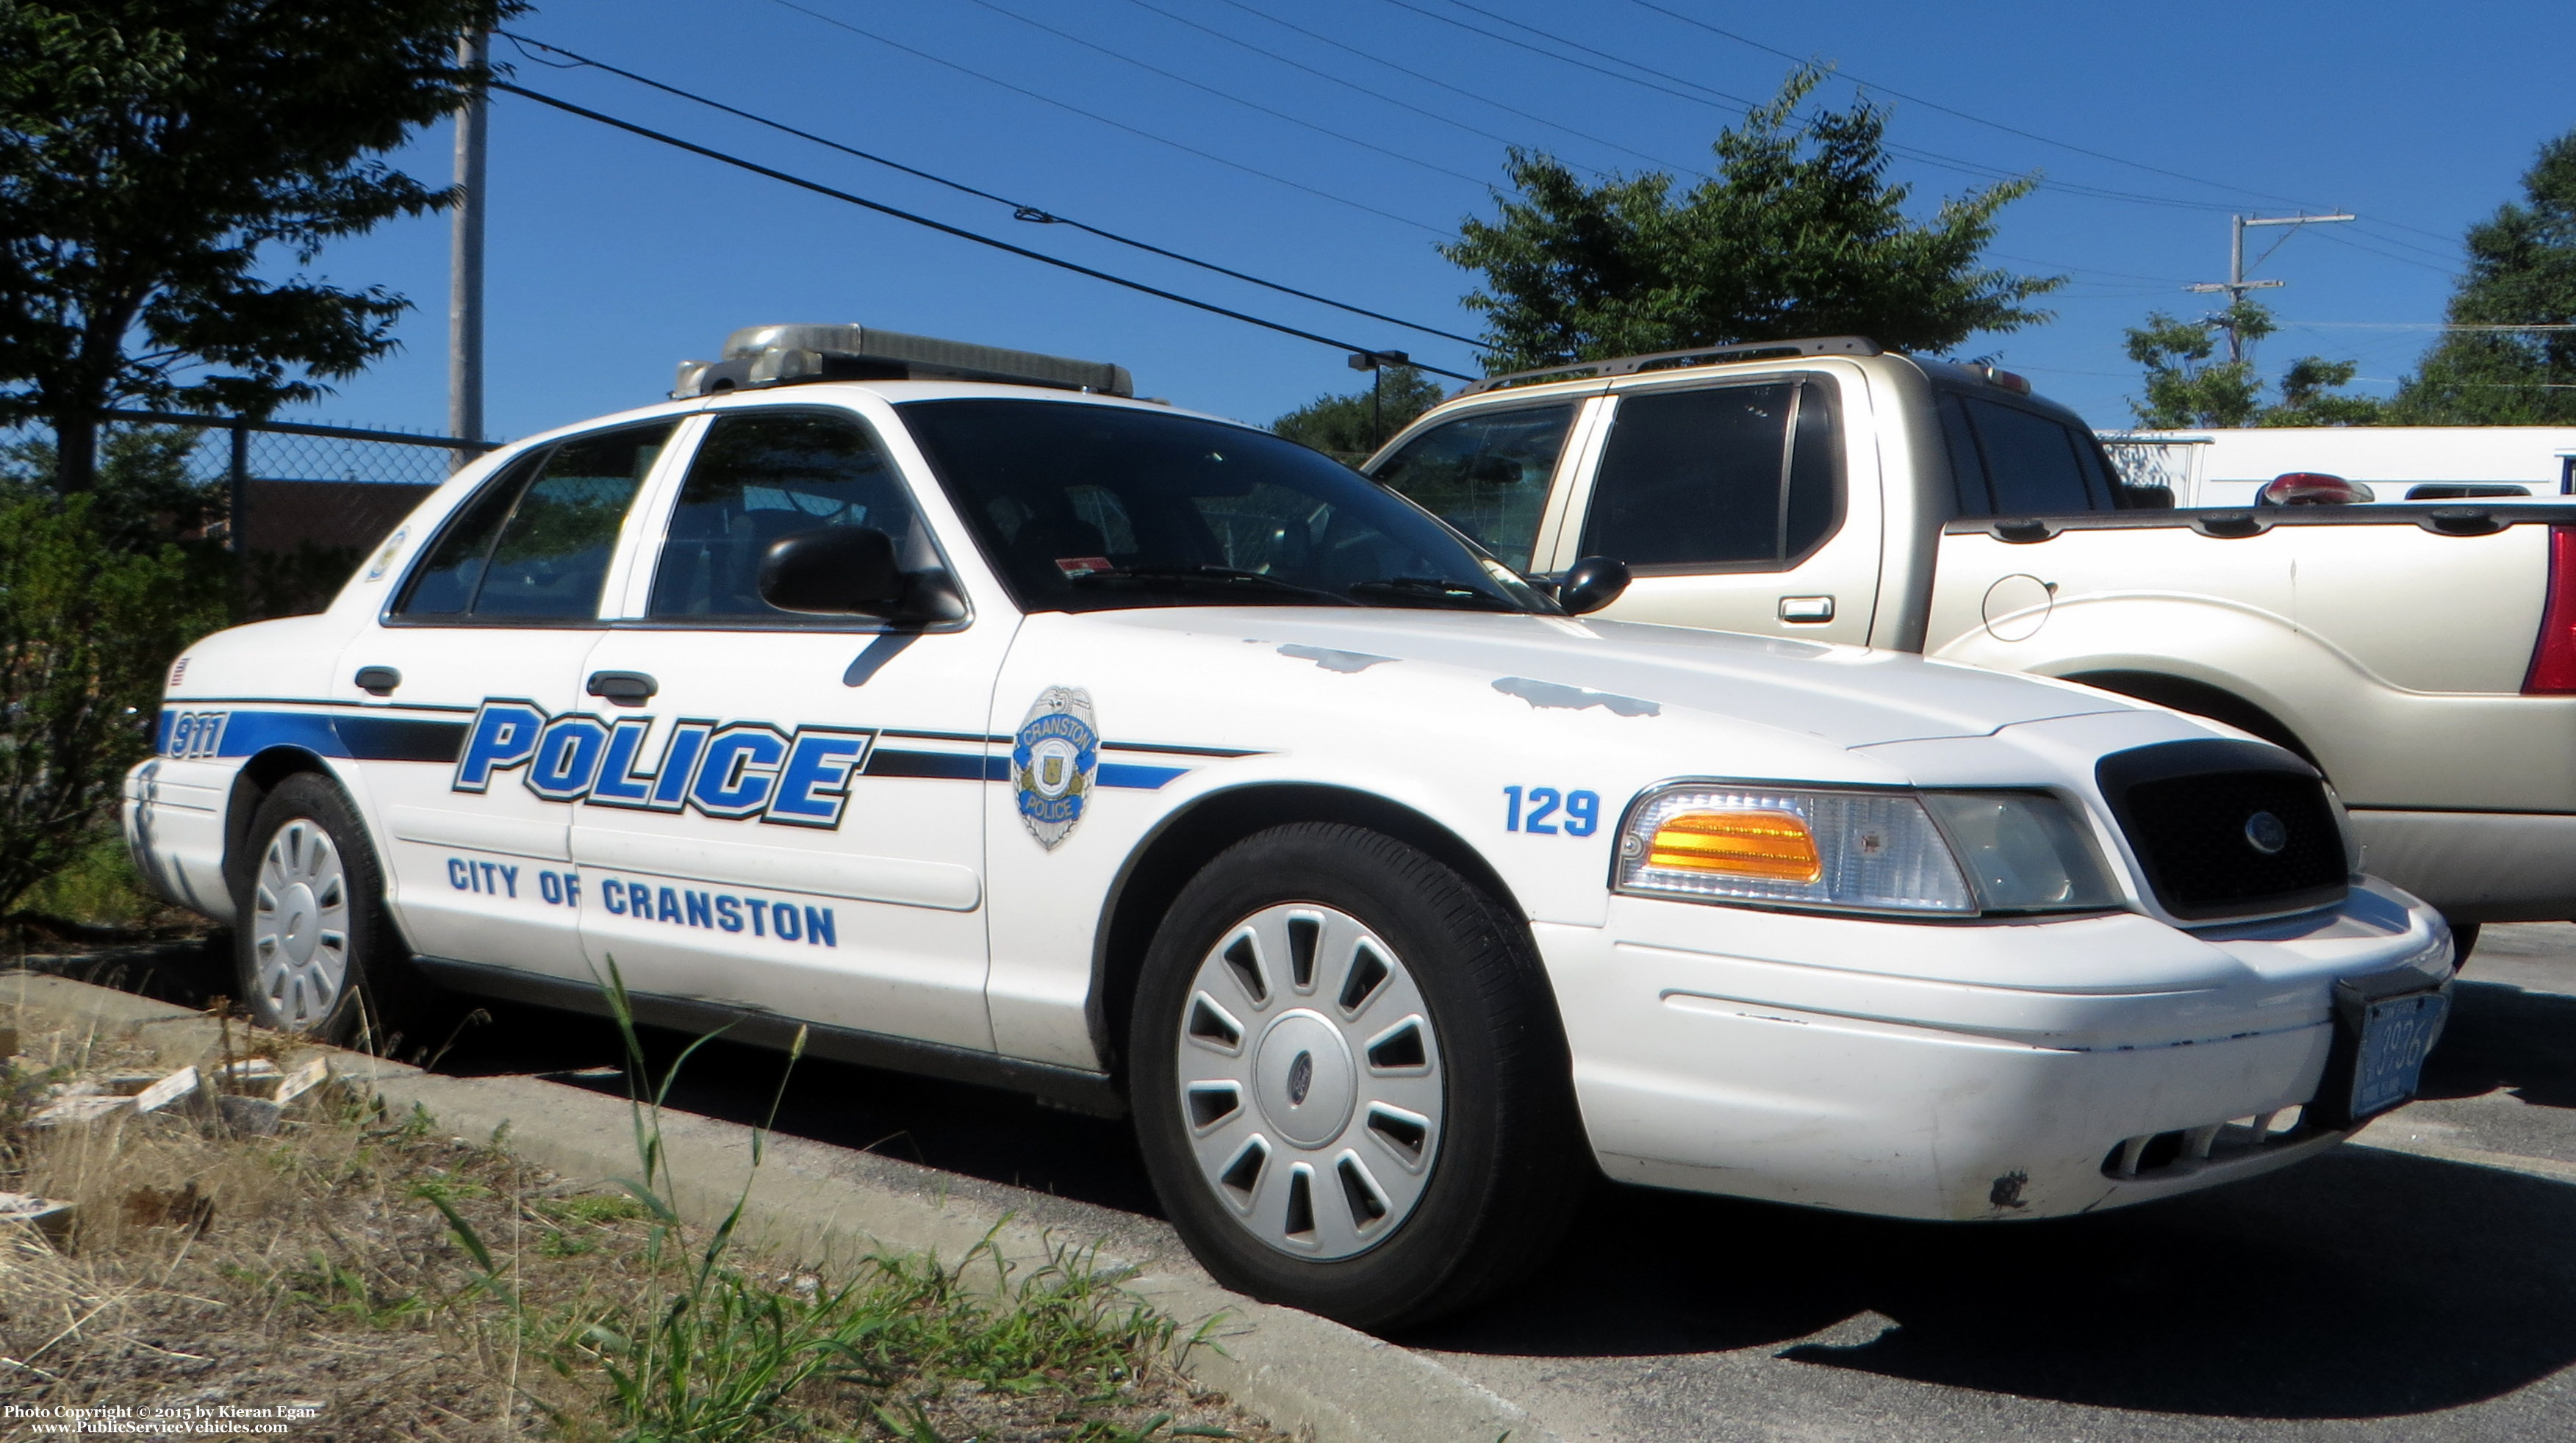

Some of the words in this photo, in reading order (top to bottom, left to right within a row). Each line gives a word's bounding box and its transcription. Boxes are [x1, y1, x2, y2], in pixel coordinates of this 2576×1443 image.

[170, 713, 227, 759] 911
[1024, 719, 1092, 750] CRANSTON
[452, 697, 877, 830] POLICE
[1027, 796, 1074, 819] POLICE
[1504, 785, 1600, 838] 129
[448, 858, 519, 899] CITY
[539, 870, 581, 908] OF
[603, 879, 837, 949] CRANSTON
